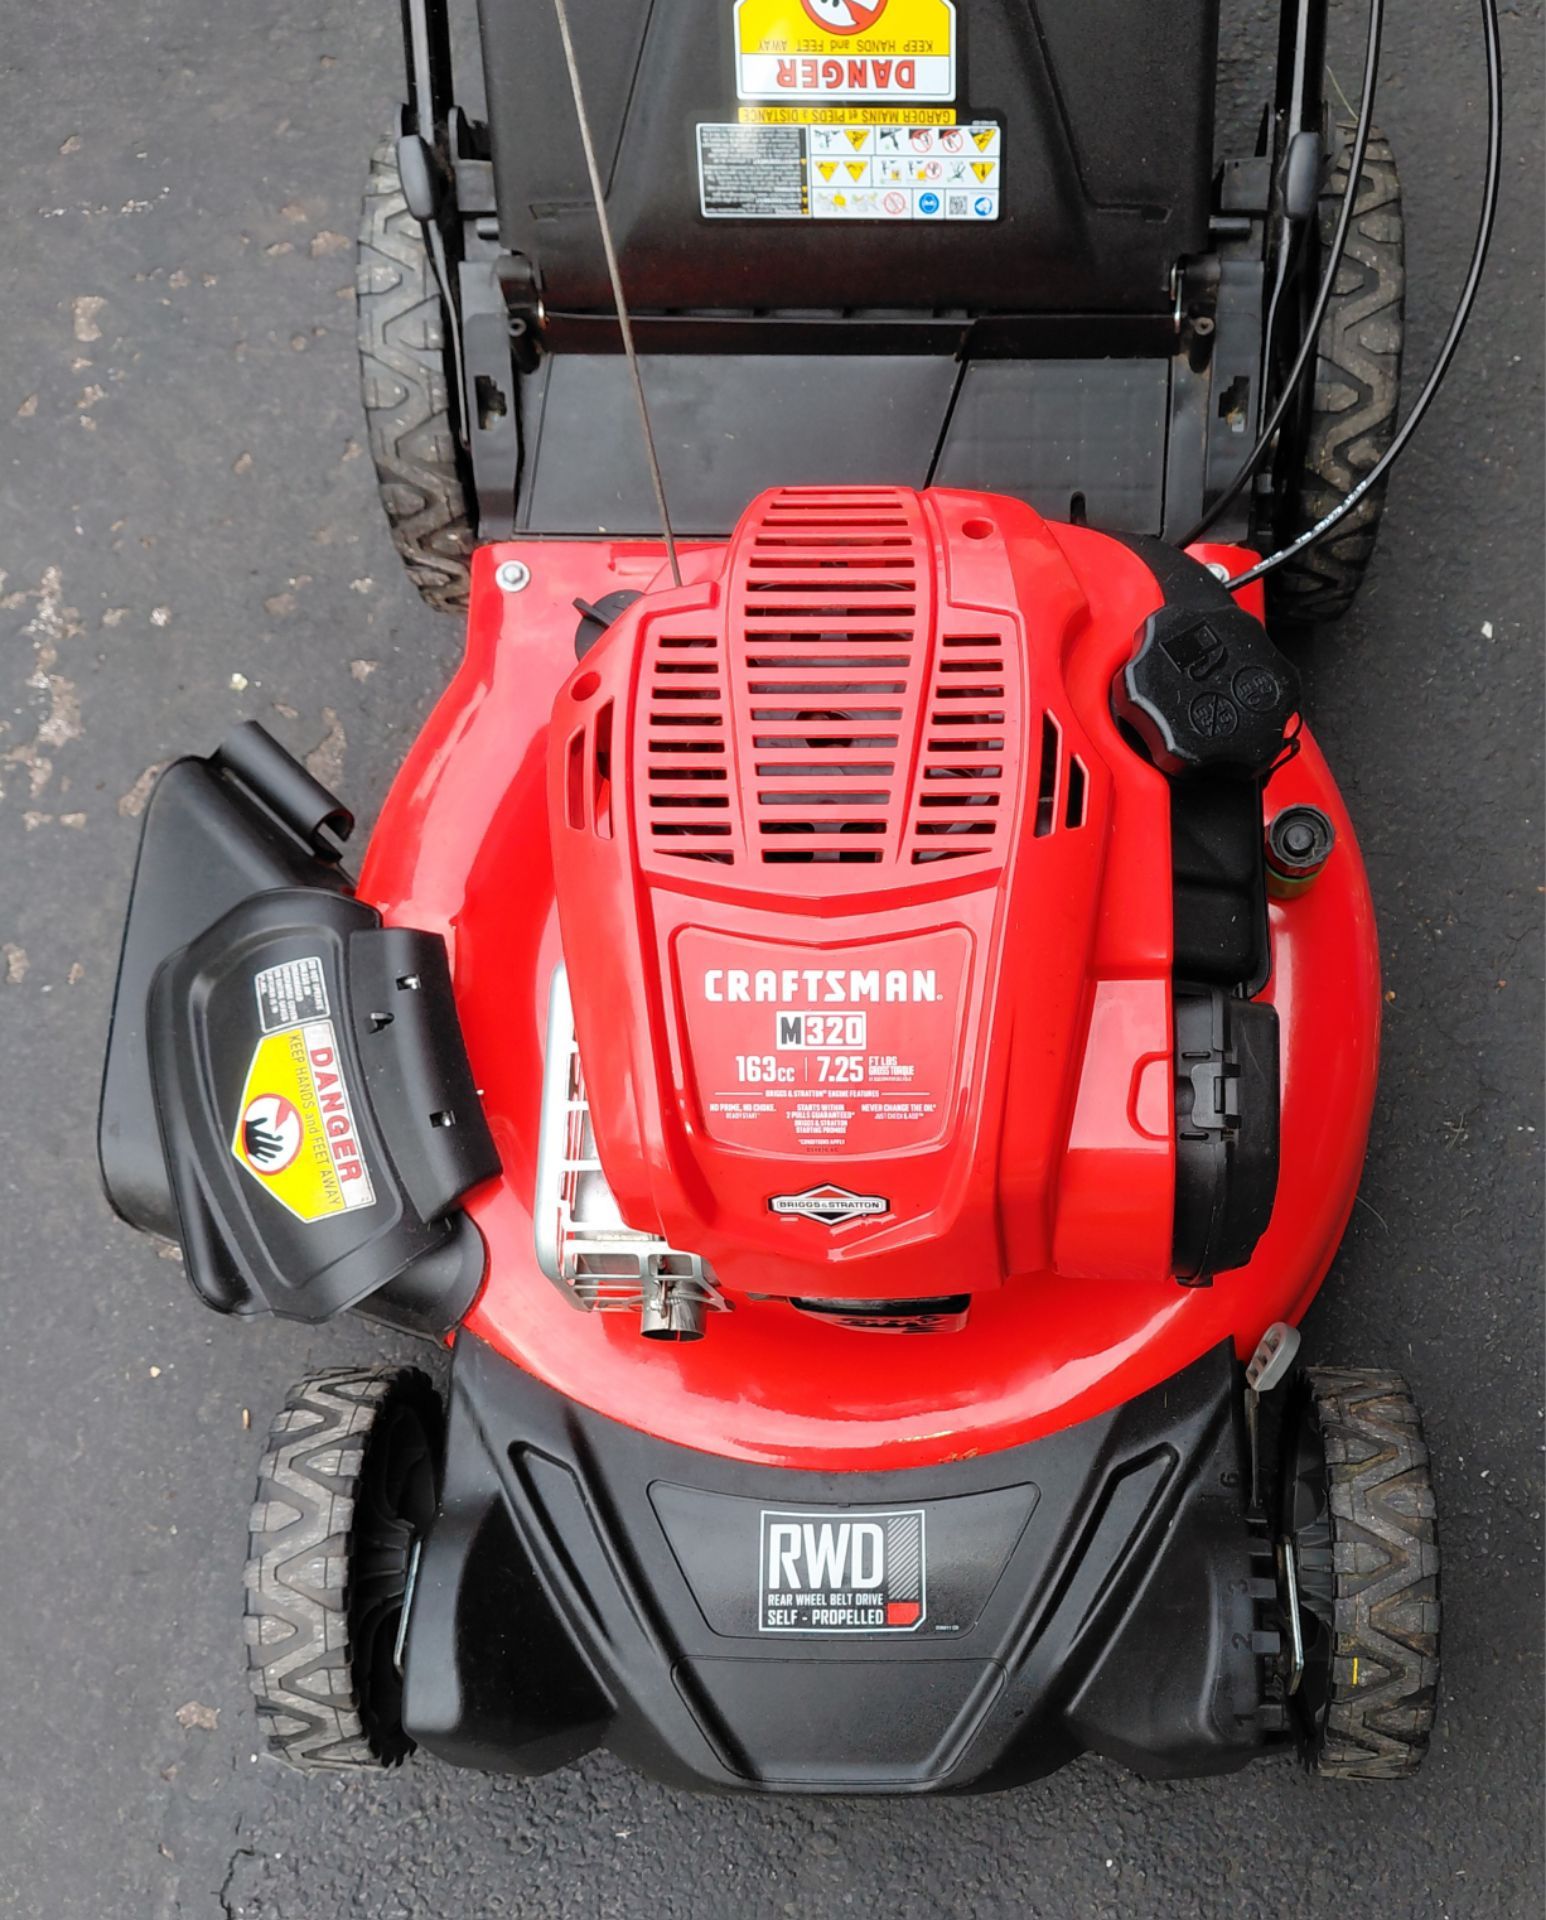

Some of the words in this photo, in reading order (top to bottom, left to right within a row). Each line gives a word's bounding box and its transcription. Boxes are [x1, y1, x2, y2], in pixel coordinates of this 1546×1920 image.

[758, 40, 787, 50] AWAY
[797, 40, 824, 51] FEET
[830, 40, 850, 51] and
[857, 40, 896, 52] HANDS
[903, 40, 933, 52] KEEP
[776, 59, 916, 89] DANGER
[743, 109, 799, 122] DISTANCE
[811, 109, 846, 122] PIEDS
[862, 110, 899, 123] MAINS
[903, 110, 950, 123] GARDER
[705, 969, 938, 1002] CRAFTSMAN
[781, 1016, 863, 1045] M320
[288, 1034, 304, 1063] KEEP
[816, 1056, 864, 1082] 7.25
[295, 1066, 314, 1110] HANDS
[304, 1113, 318, 1134] and
[310, 1047, 362, 1183] DANGER
[311, 1136, 329, 1166] FEET
[320, 1168, 340, 1206] AWAY
[768, 1524, 884, 1589] RWD
[768, 1593, 792, 1606] REAR
[796, 1593, 827, 1606] WHEEL
[830, 1593, 852, 1606] BELT
[856, 1593, 884, 1606] DRIVE
[768, 1609, 798, 1625] SELF
[812, 1609, 884, 1625] PROPELLED
[1231, 1632, 1252, 1651] 2
